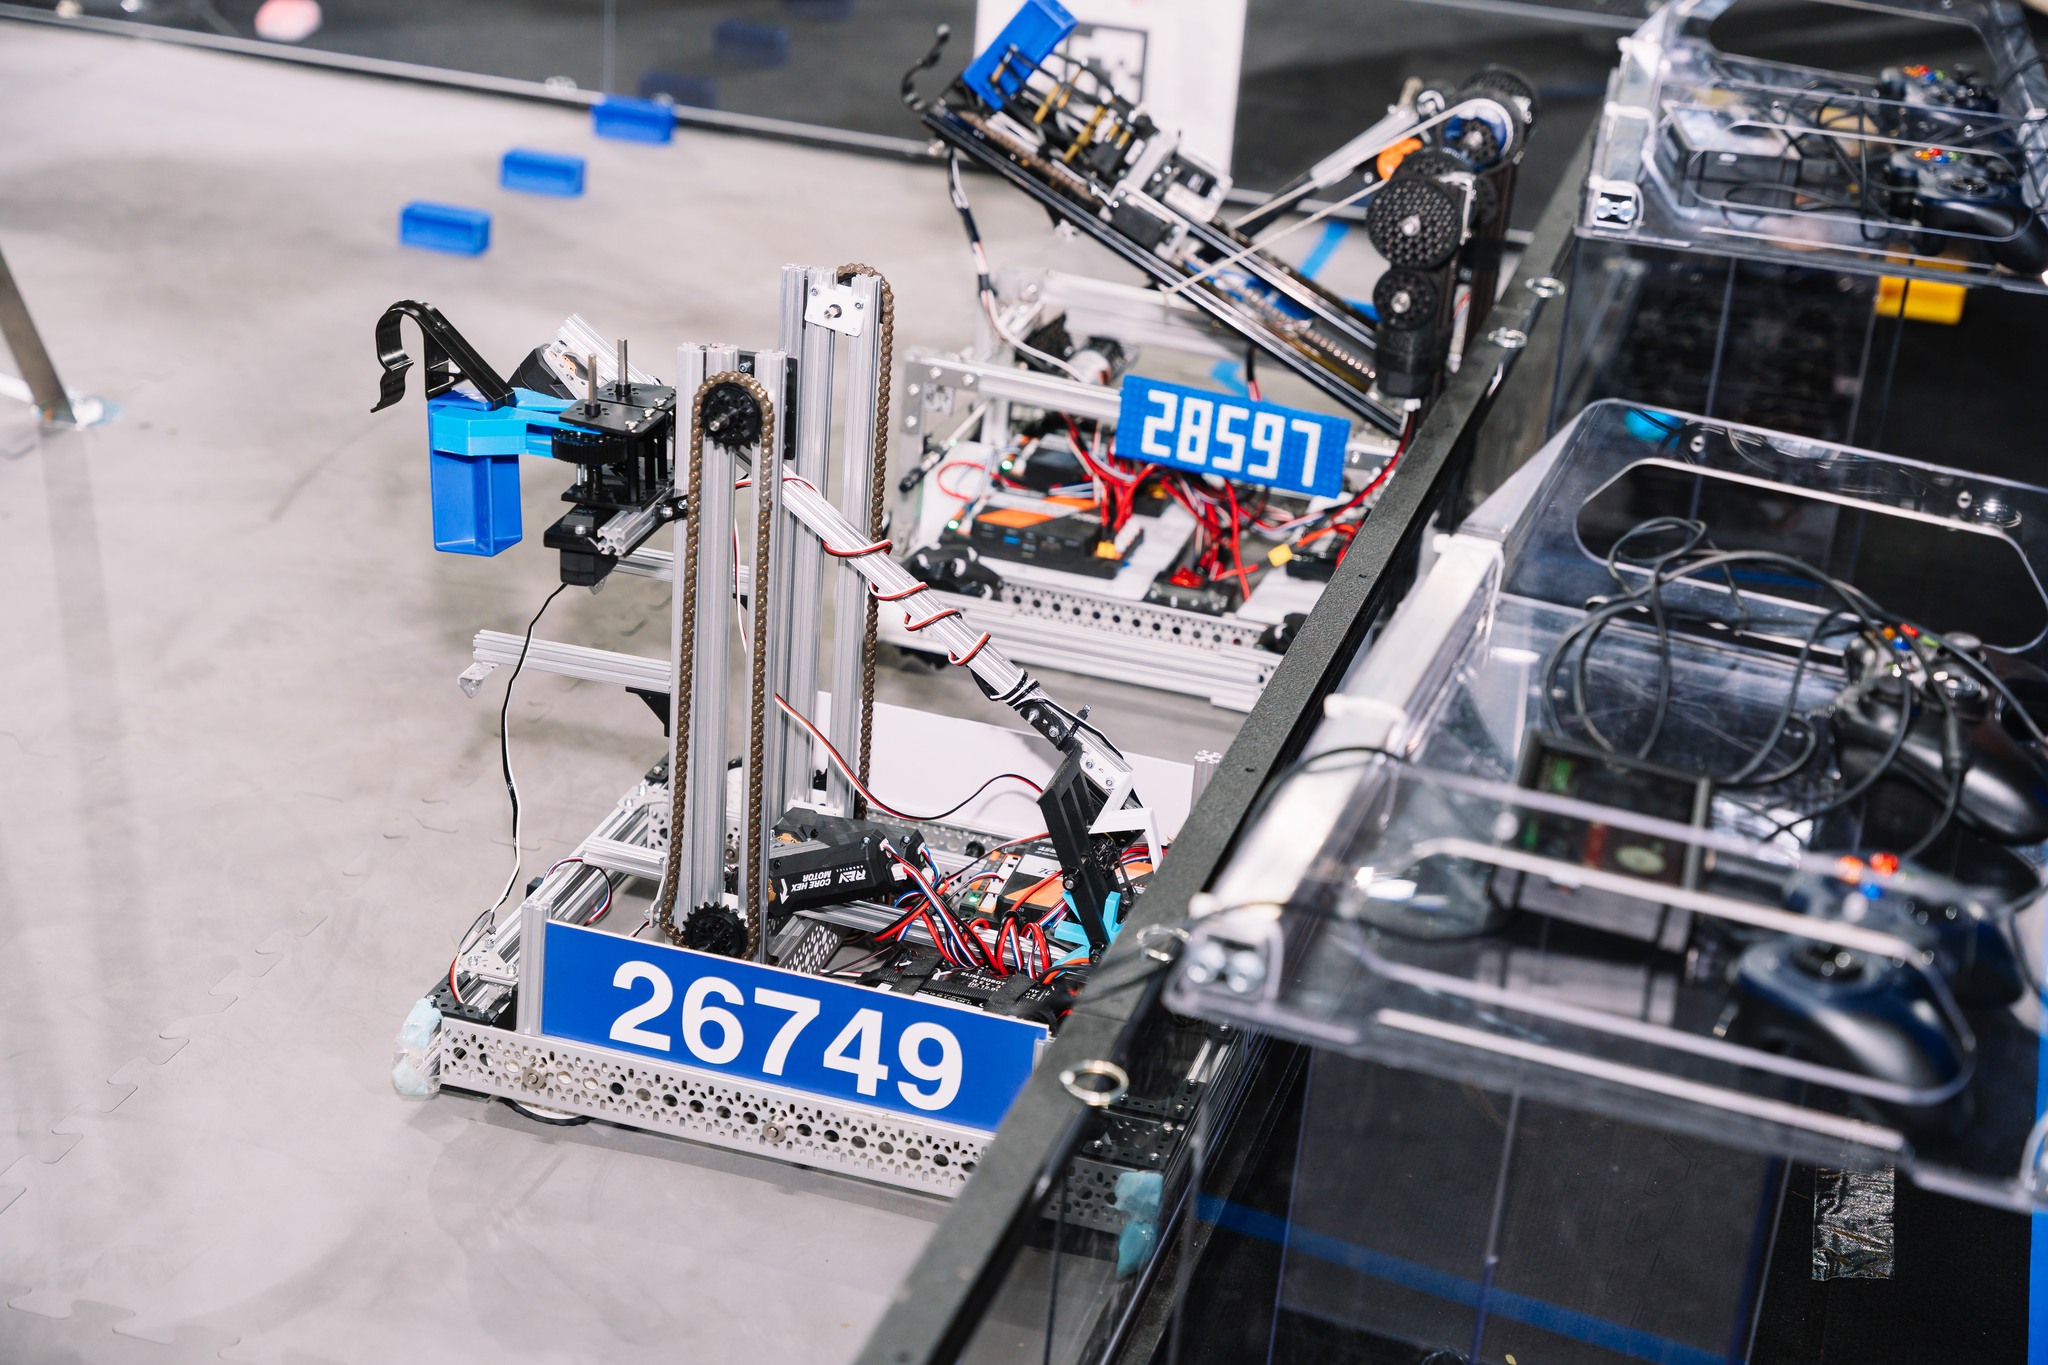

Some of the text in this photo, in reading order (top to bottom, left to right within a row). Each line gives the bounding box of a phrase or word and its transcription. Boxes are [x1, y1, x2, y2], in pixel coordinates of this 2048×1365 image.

[1141, 389, 1322, 487] 28597
[803, 871, 832, 882] MOTOR
[838, 869, 867, 884] REV
[791, 879, 831, 892] CORE HEX
[981, 977, 1006, 985] ROBOT
[610, 961, 963, 1111] 26749
